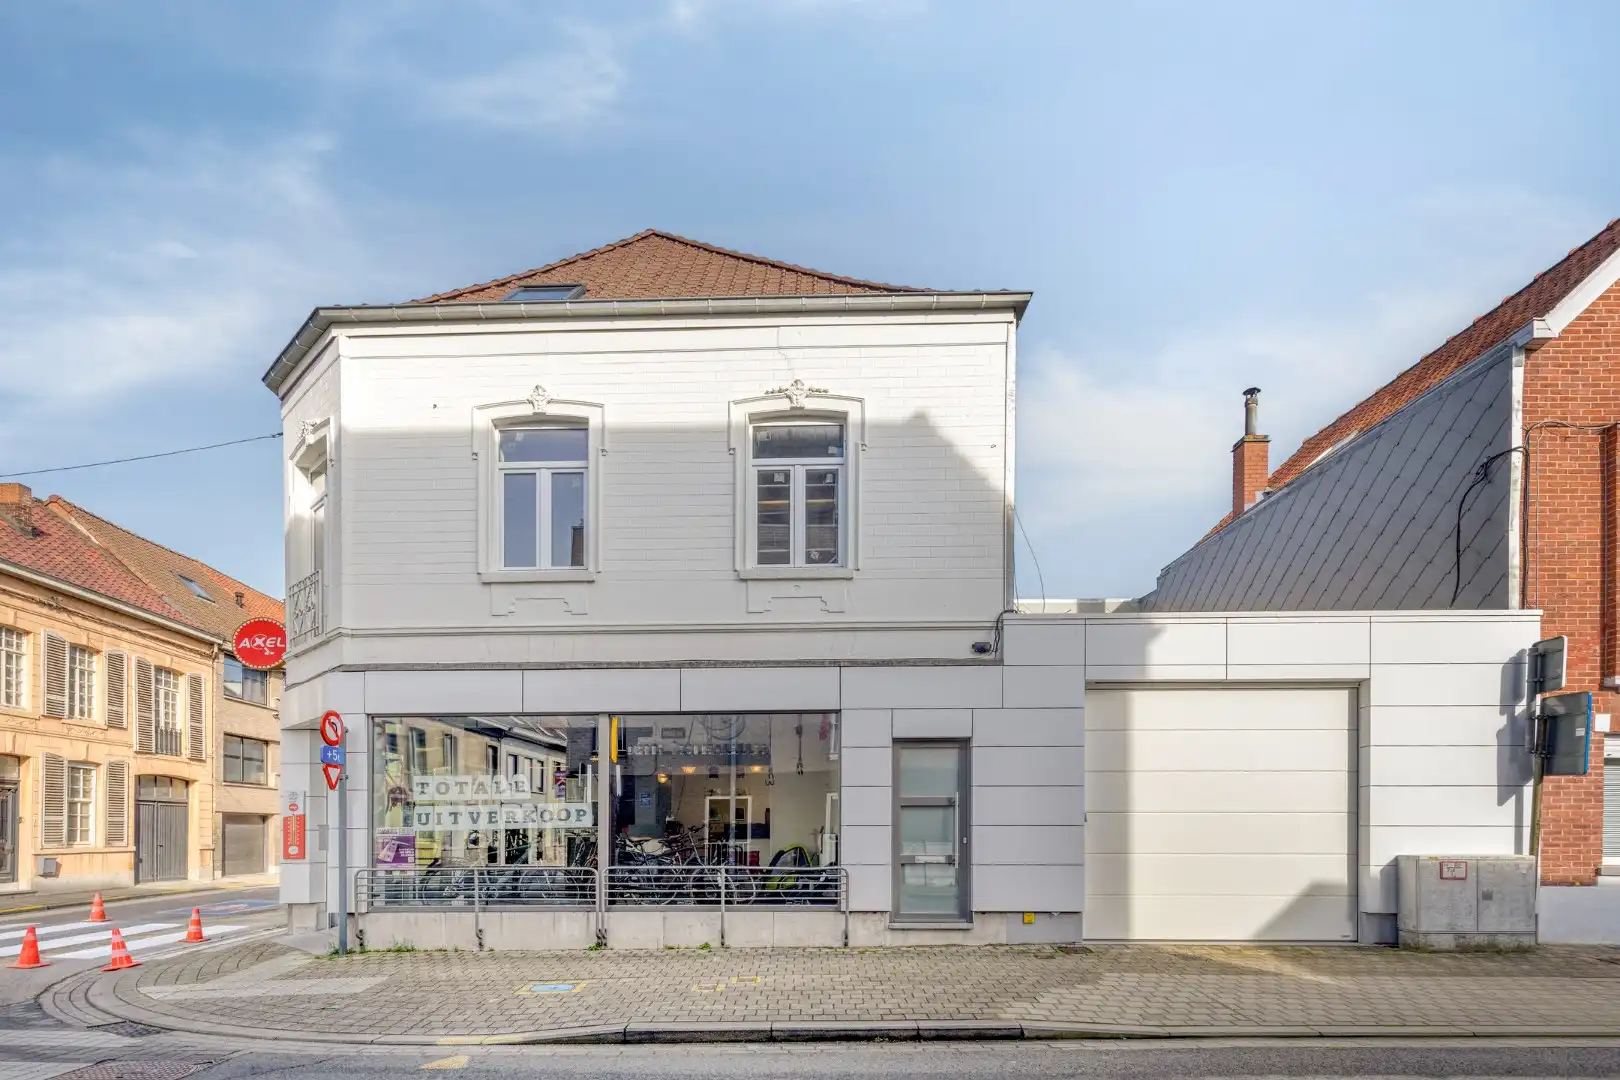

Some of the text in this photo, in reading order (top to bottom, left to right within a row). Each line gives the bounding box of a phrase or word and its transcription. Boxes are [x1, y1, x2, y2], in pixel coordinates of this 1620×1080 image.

[238, 635, 286, 649] AXEL
[415, 780, 526, 796] TOTALE
[415, 808, 587, 826] UITVERKOOP
